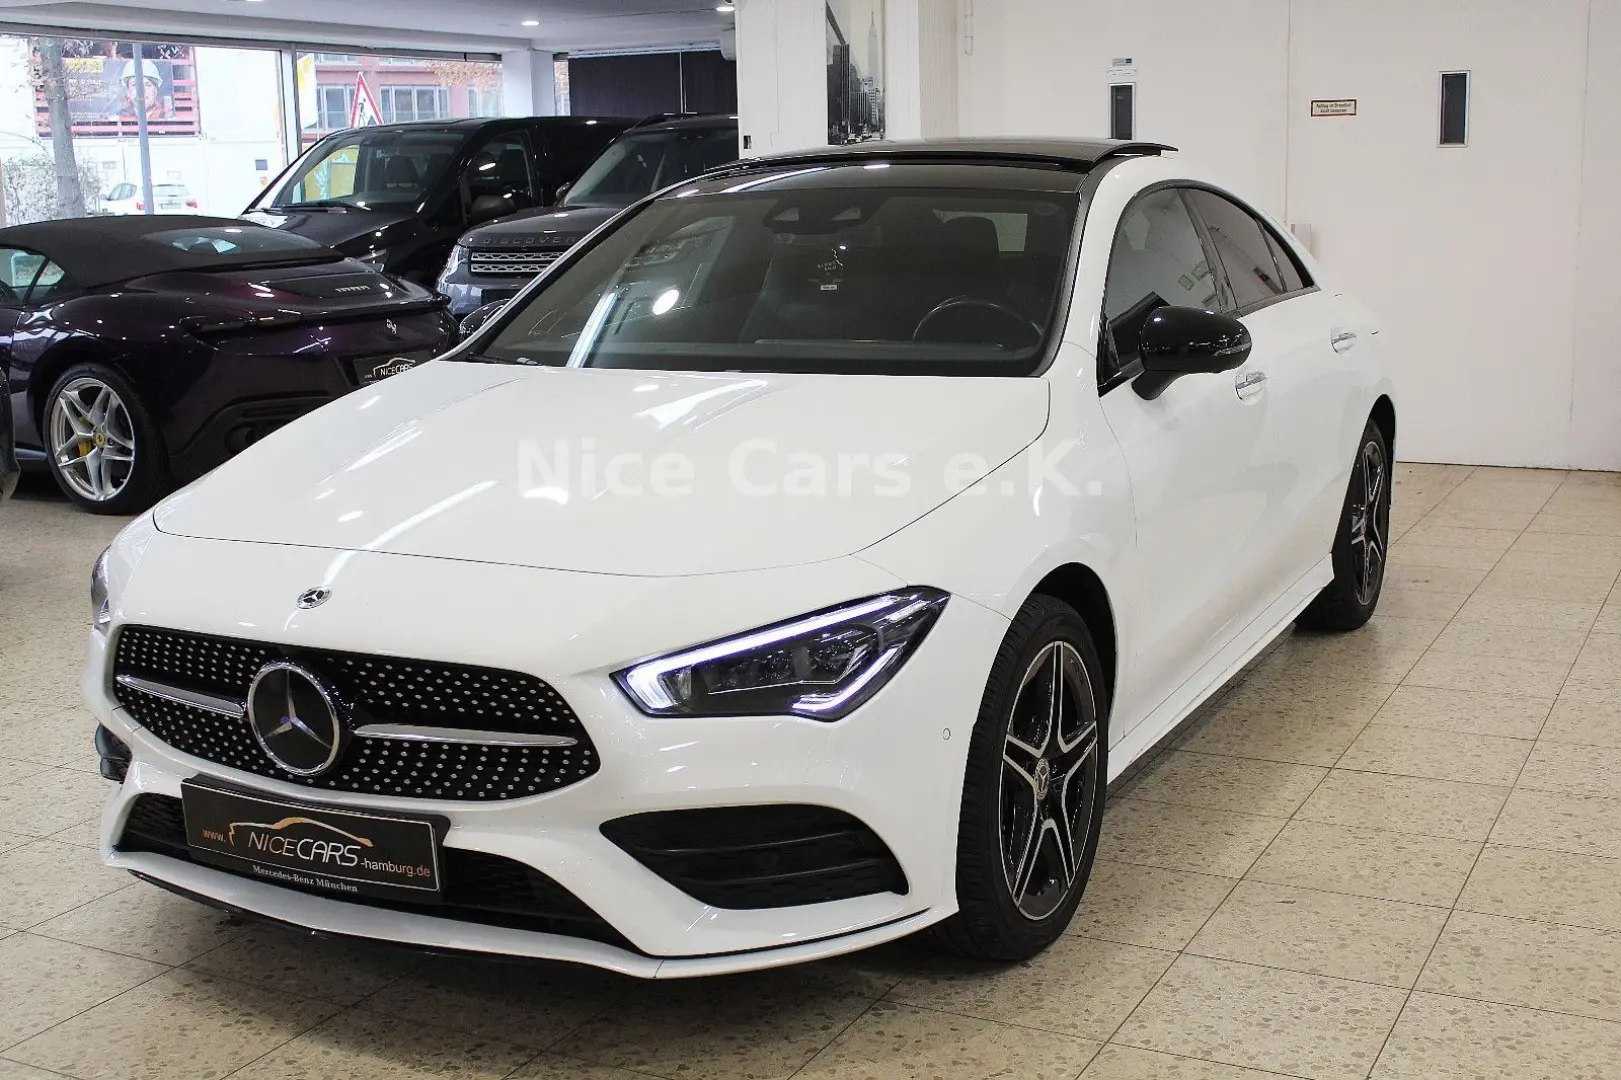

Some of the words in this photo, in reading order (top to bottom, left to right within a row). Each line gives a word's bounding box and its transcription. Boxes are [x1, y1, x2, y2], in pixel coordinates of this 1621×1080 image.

[482, 235, 577, 245] DISCOVER
[202, 828, 227, 843] www.
[252, 864, 315, 885] Mercedes-Benz
[316, 877, 358, 892] München
